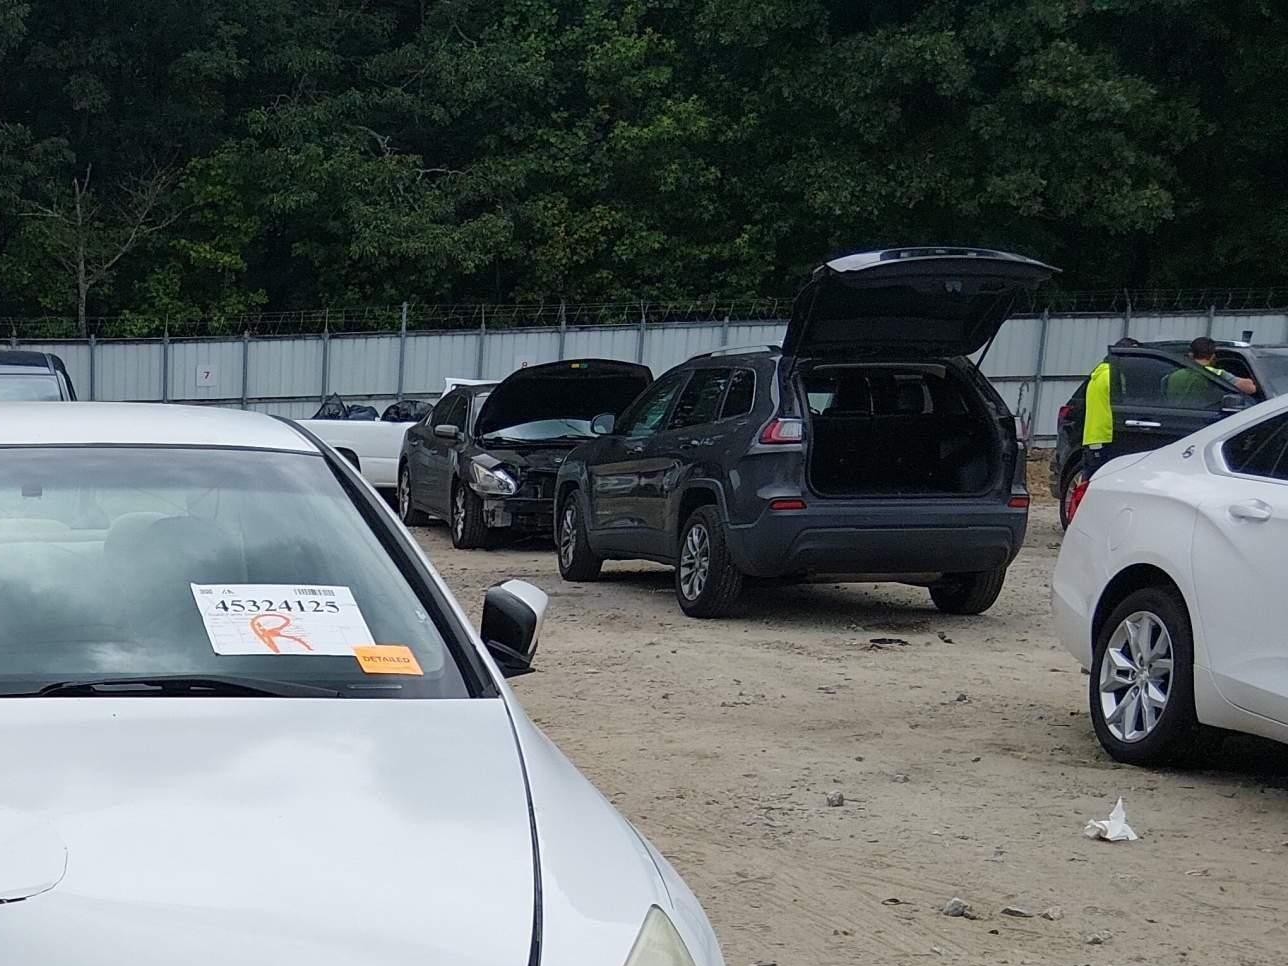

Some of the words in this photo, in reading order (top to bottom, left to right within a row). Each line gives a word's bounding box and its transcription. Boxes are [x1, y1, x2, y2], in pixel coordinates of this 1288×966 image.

[203, 371, 210, 379] 7
[215, 599, 340, 614] 45324125
[249, 613, 314, 654] R
[363, 655, 411, 664] DETAILED
